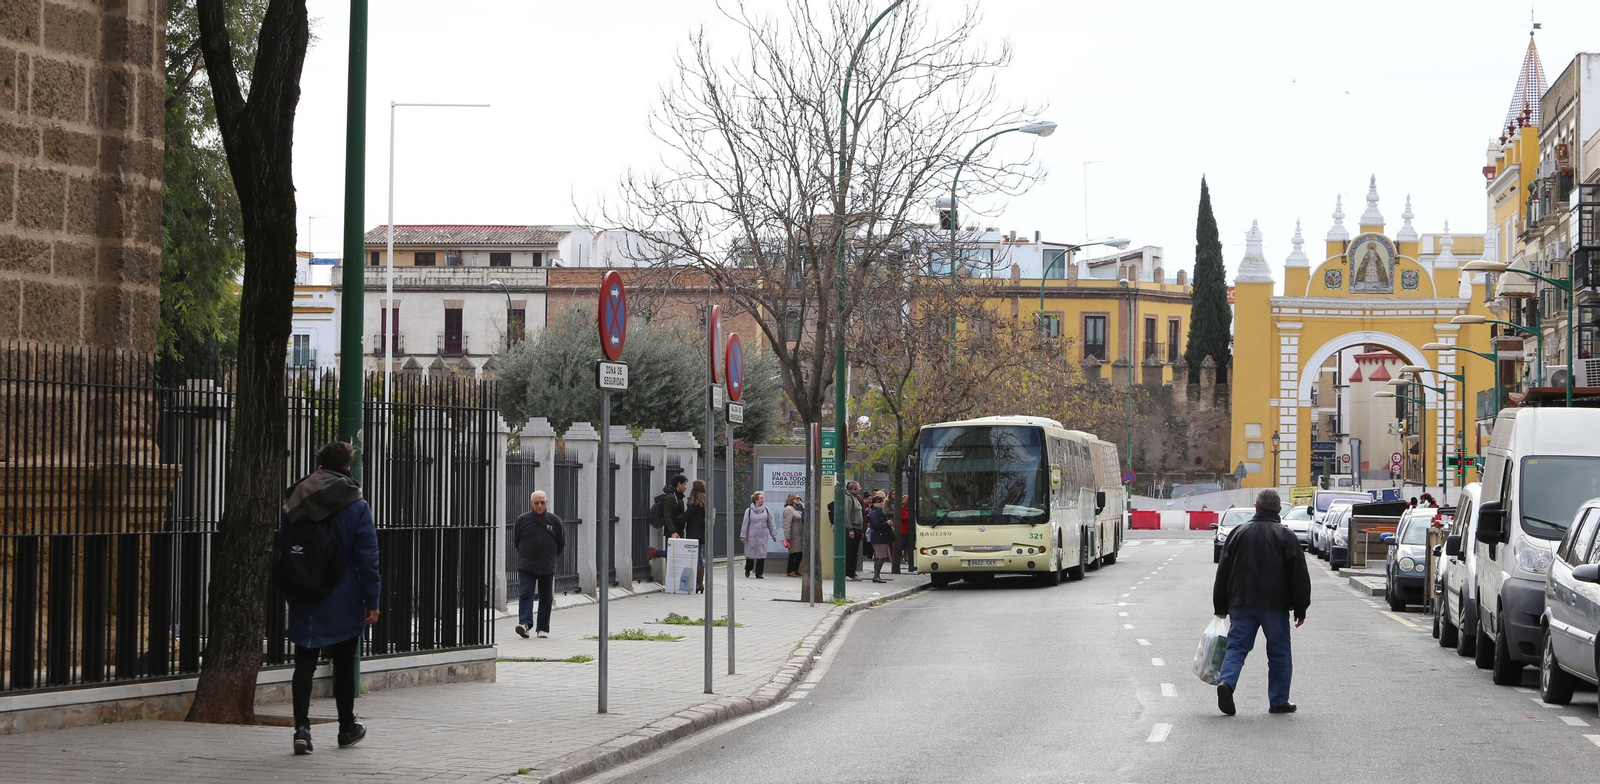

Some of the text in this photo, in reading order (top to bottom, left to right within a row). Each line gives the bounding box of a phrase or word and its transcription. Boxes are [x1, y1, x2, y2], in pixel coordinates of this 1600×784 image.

[606, 366, 622, 375] ZONA DE
[604, 376, 624, 386] SEGURIDAD
[1028, 532, 1043, 540] 321
